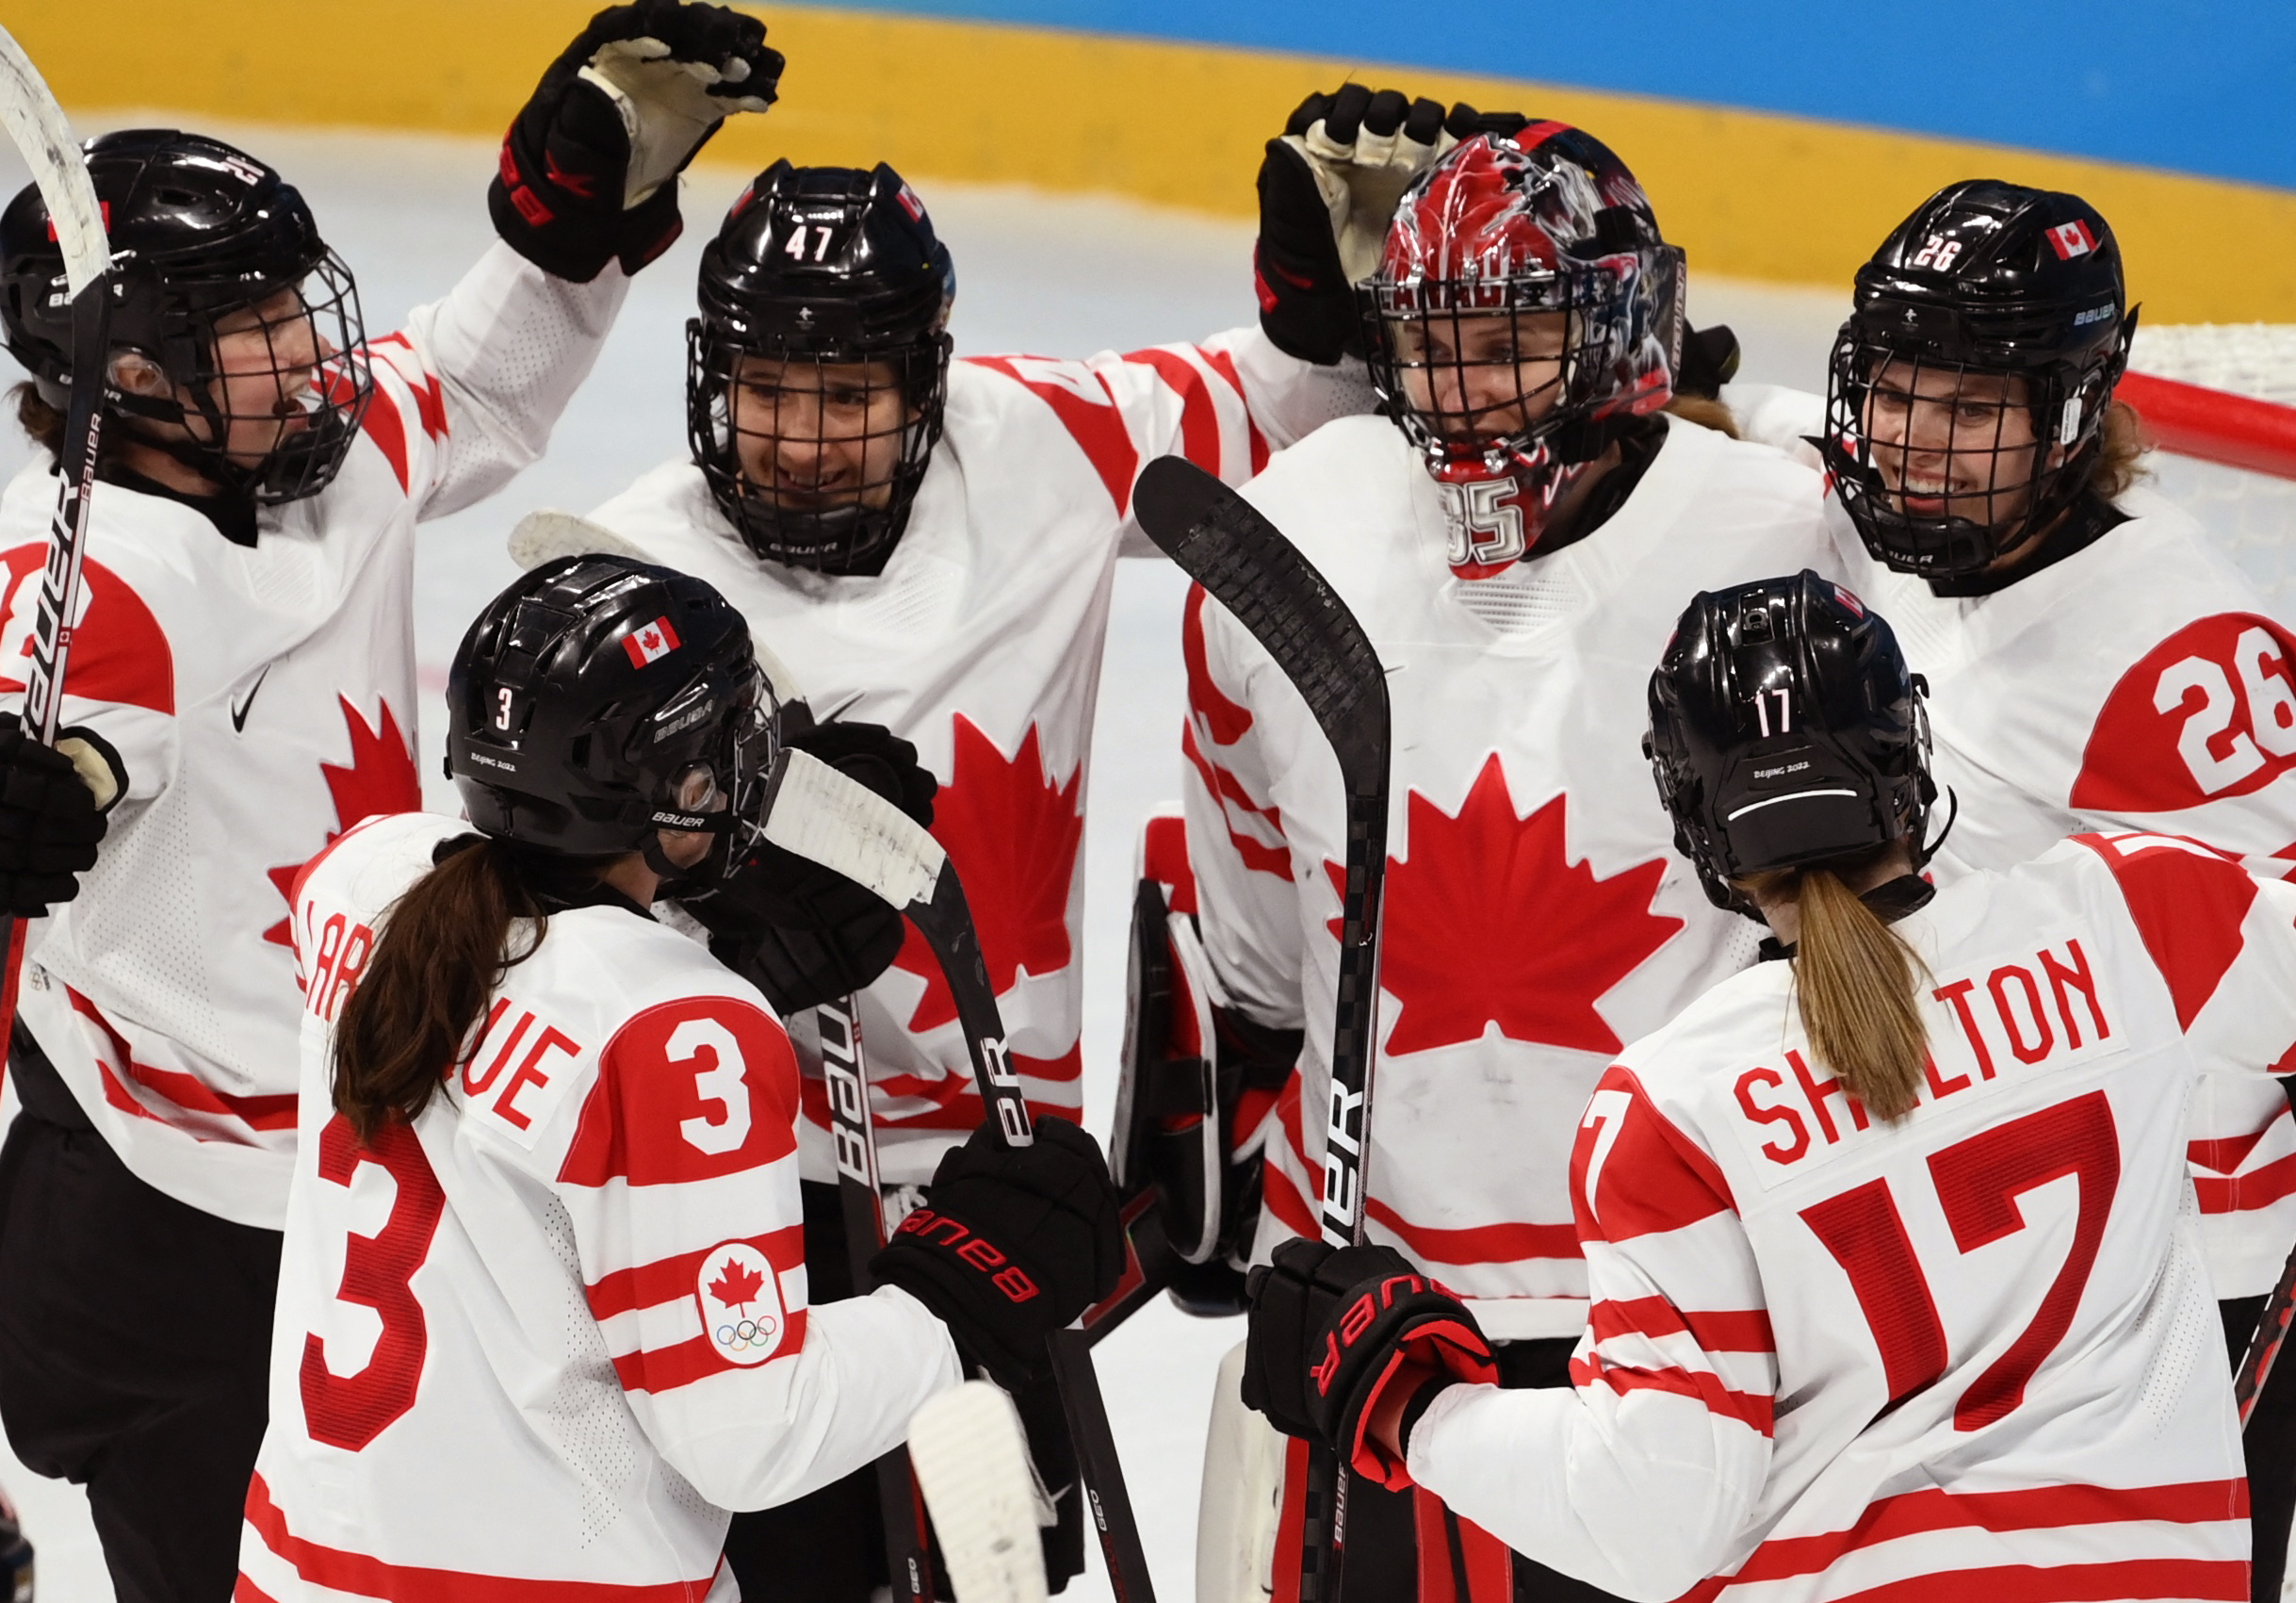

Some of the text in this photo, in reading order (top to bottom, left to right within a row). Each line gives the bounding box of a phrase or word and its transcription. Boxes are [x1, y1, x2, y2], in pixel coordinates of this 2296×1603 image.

[784, 224, 833, 262] 47
[1913, 234, 1962, 272] 26
[2074, 303, 2116, 326] BAUER
[81, 412, 102, 501] BAUER
[19, 467, 79, 743] AUER
[495, 687, 513, 731] 3
[1754, 688, 1790, 738] 17
[2152, 625, 2296, 796] 26
[651, 810, 706, 828] BAUER
[1752, 761, 1812, 779] BEIJING 2022
[664, 1018, 753, 1156] 3
[816, 994, 871, 1187] BAU
[1733, 938, 2110, 1166] SHLTON
[1578, 1089, 1634, 1225] 7
[299, 1098, 448, 1453] 3
[1797, 1088, 2122, 1432] 17
